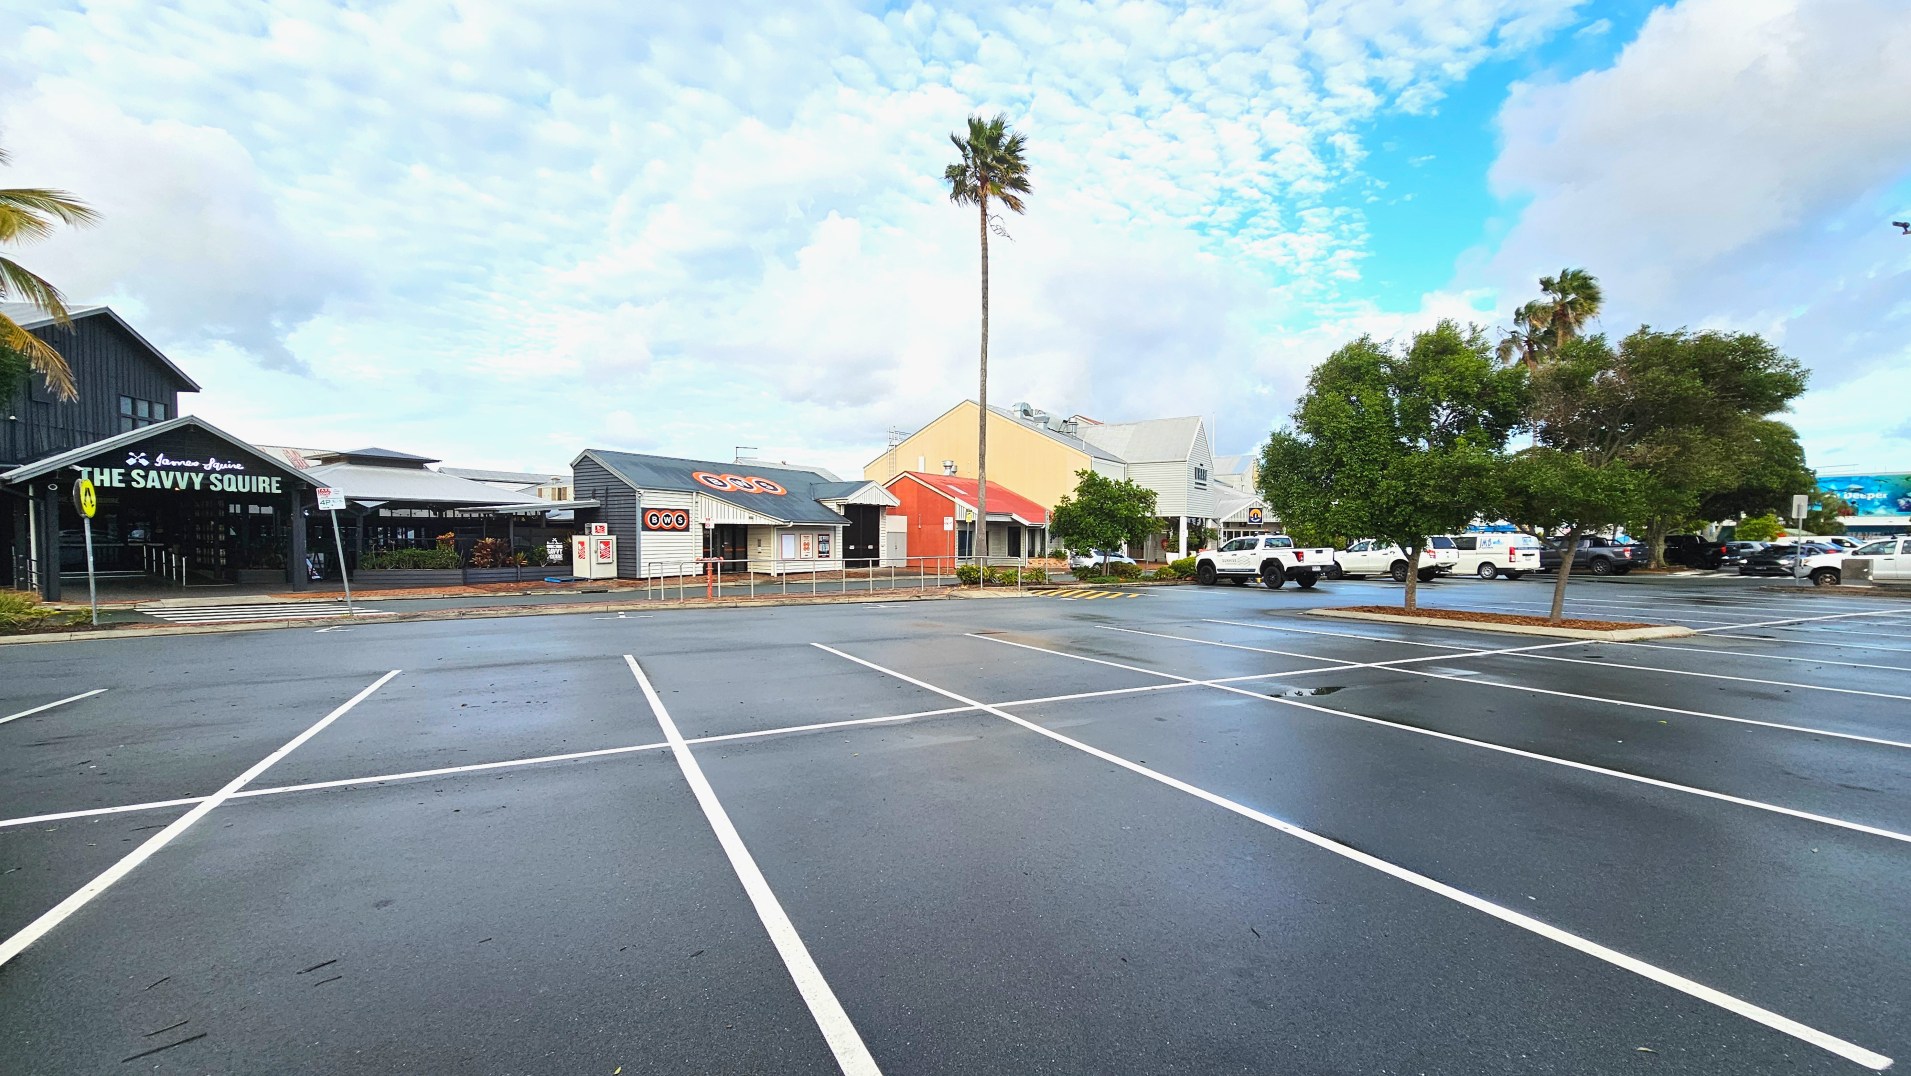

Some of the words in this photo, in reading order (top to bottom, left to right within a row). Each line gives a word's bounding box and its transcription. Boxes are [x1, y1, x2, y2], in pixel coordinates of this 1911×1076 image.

[155, 453, 200, 467] James
[203, 457, 245, 471] Squire
[81, 467, 126, 487] THE
[130, 469, 204, 490] SAVVY
[210, 473, 282, 493] SQUIRE
[651, 515, 683, 524] BWS
